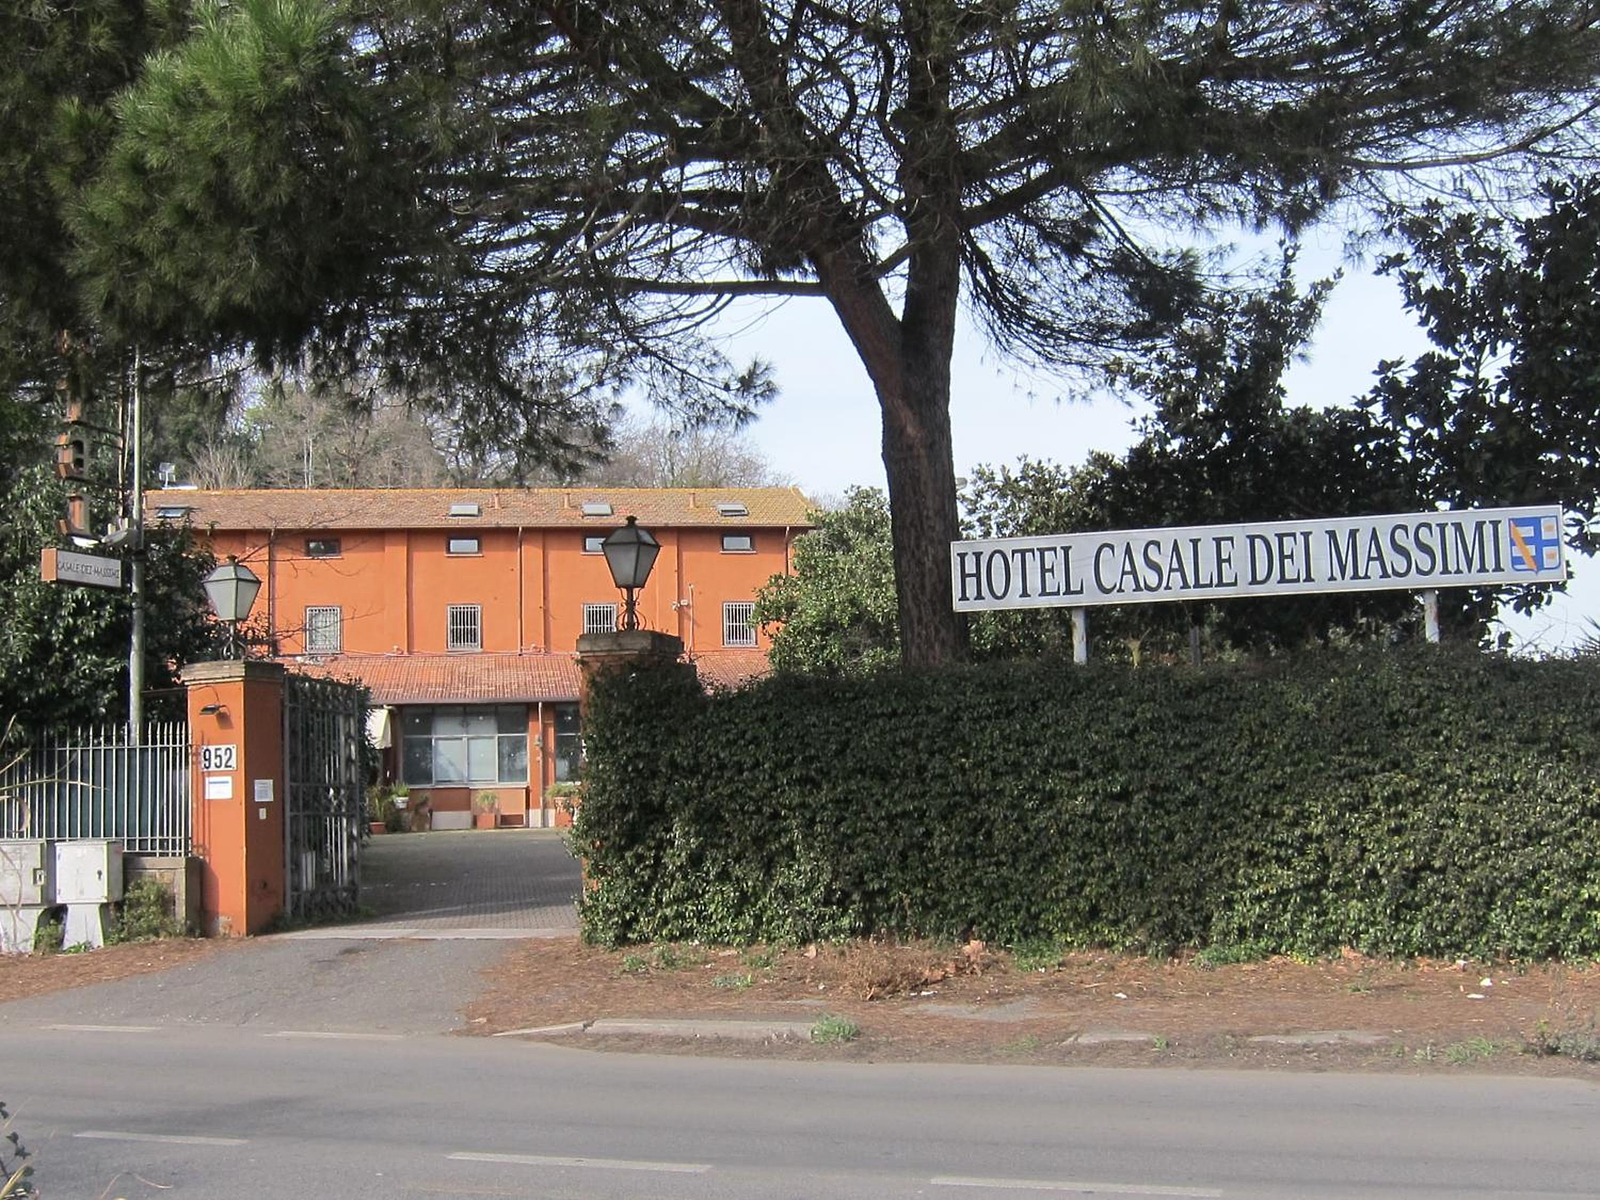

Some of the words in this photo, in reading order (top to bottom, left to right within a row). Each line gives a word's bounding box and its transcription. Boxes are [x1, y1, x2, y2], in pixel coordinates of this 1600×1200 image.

[58, 561, 79, 574] CASALE
[956, 545, 1084, 602] HOTEL
[1093, 536, 1238, 595] CASALE
[1246, 530, 1315, 586] DEI
[1325, 519, 1505, 582] MASSIMI
[203, 747, 232, 770] 952
